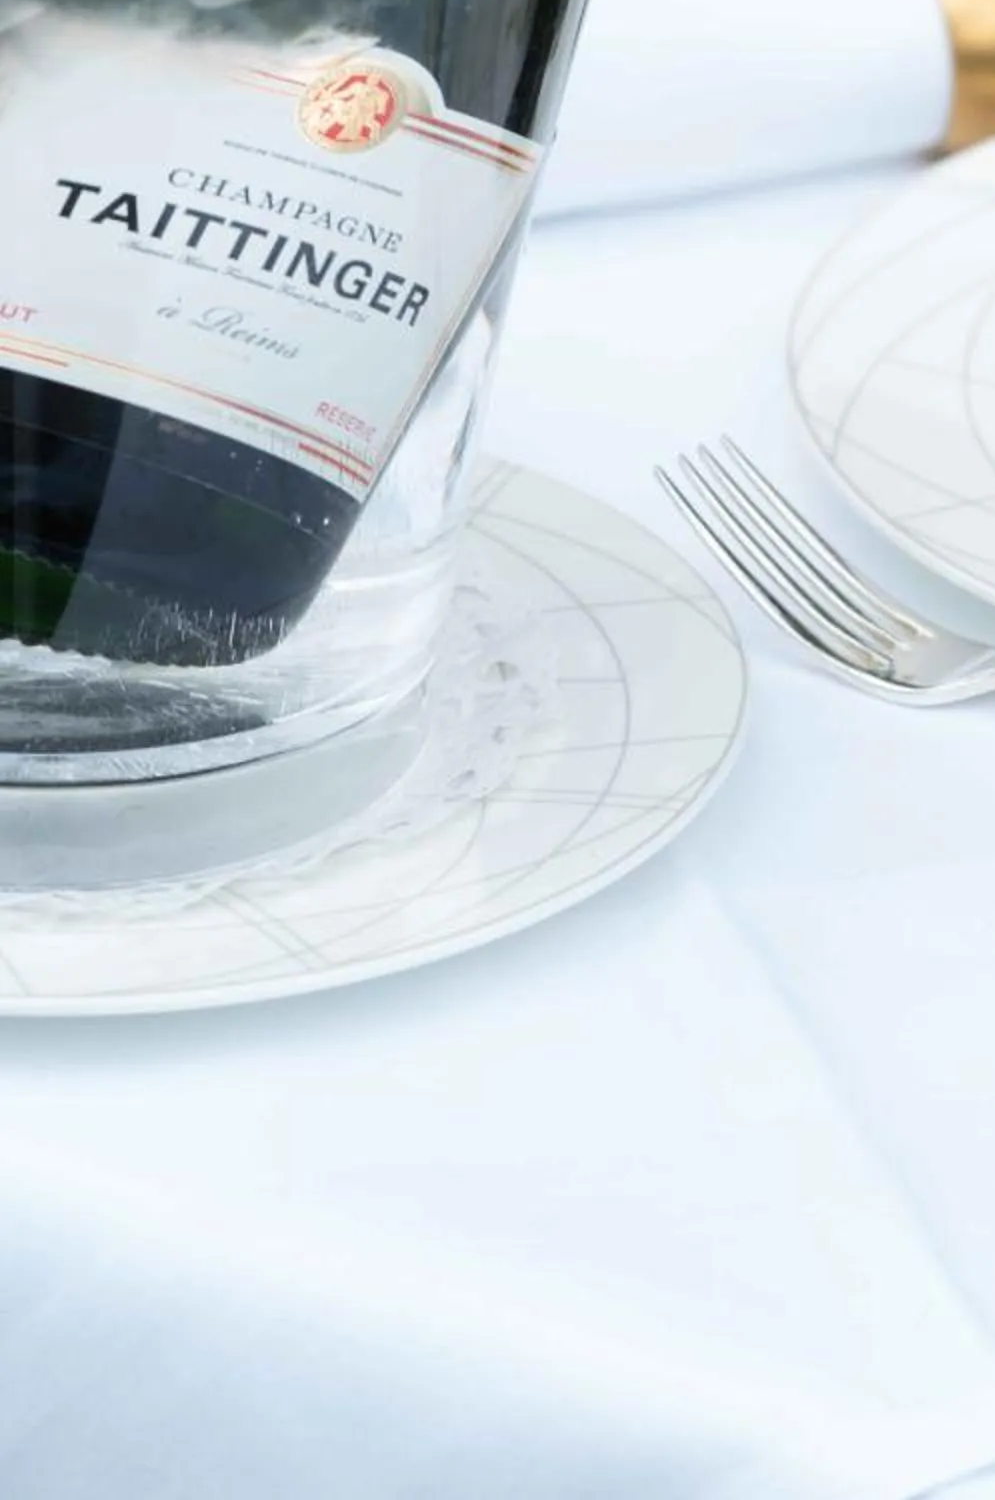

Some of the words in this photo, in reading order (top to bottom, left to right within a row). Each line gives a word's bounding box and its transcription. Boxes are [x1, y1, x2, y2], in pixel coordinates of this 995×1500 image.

[56, 179, 430, 327] TAITTINGER
[167, 167, 404, 253] CHAMPAGNE
[189, 305, 300, 359] Reims
